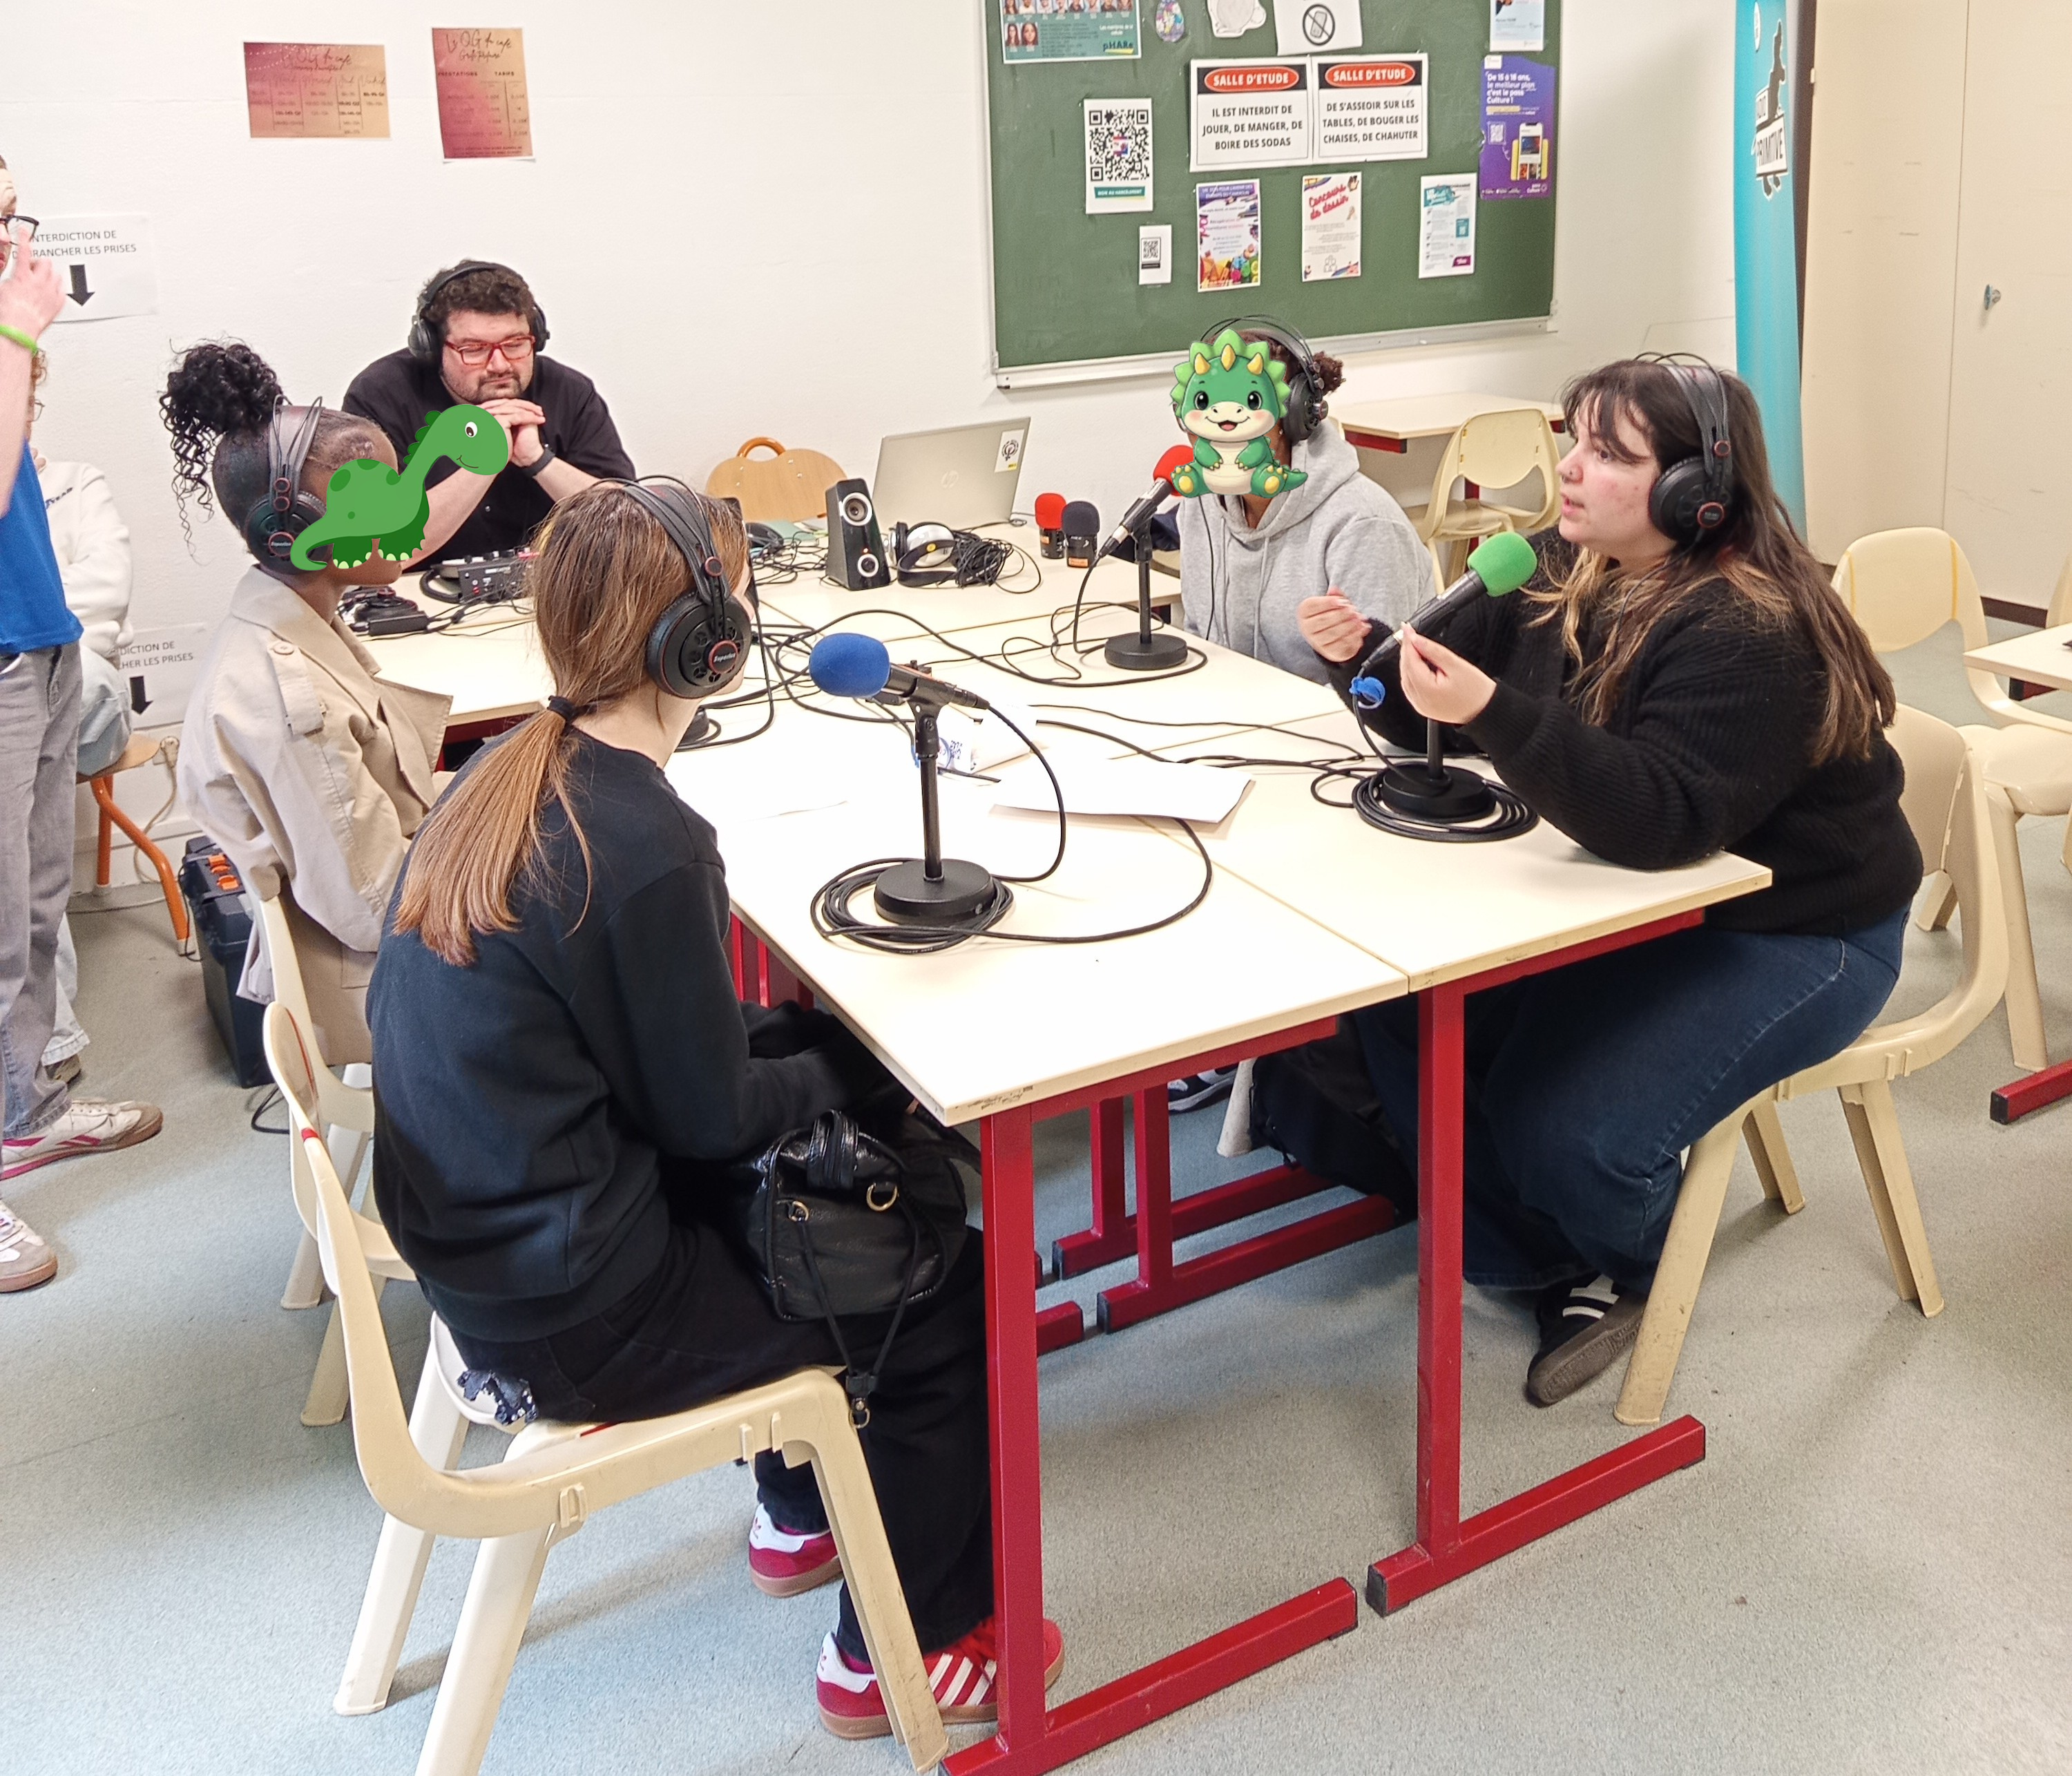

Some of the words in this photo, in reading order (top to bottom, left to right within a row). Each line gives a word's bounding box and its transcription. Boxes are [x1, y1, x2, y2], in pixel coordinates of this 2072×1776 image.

[1214, 74, 1243, 86] SALLE
[1247, 73, 1289, 85] D'ETUDE
[1333, 70, 1363, 82] SALLE
[1365, 68, 1406, 81] D'ETUDE
[1212, 108, 1220, 117] IL
[1222, 108, 1236, 117] EST
[1238, 106, 1279, 116] INTERDIT
[1281, 105, 1292, 114] DE
[1327, 103, 1337, 111] DE
[1339, 101, 1381, 111] S'ASSEOIR
[1383, 100, 1399, 109] SUR
[1401, 99, 1414, 108] LES
[1323, 117, 1355, 128] TABLES,
[1357, 117, 1368, 126] DE
[1370, 116, 1403, 125] BOUGER
[1406, 115, 1419, 124] LES
[1202, 124, 1231, 137] JOUER,
[1234, 124, 1245, 133] DE
[1248, 122, 1289, 132] MANGER,
[1292, 120, 1303, 130] DE
[1216, 140, 1240, 150] BOIRE
[1243, 139, 1259, 148] DES
[1261, 137, 1291, 147] SODAS
[1323, 133, 1360, 144] CHAISES,
[1363, 133, 1372, 142] DE
[1375, 131, 1418, 141] CHAHUTER
[32, 231, 101, 242] NTERDICTION
[104, 230, 117, 239] DE
[12, 247, 81, 259] DRANCHER
[84, 245, 101, 255] LES
[104, 244, 137, 254] PRISES
[120, 643, 160, 656] DICTION
[162, 641, 175, 650] DE
[144, 658, 160, 667] LES
[162, 653, 194, 664] PRISES
